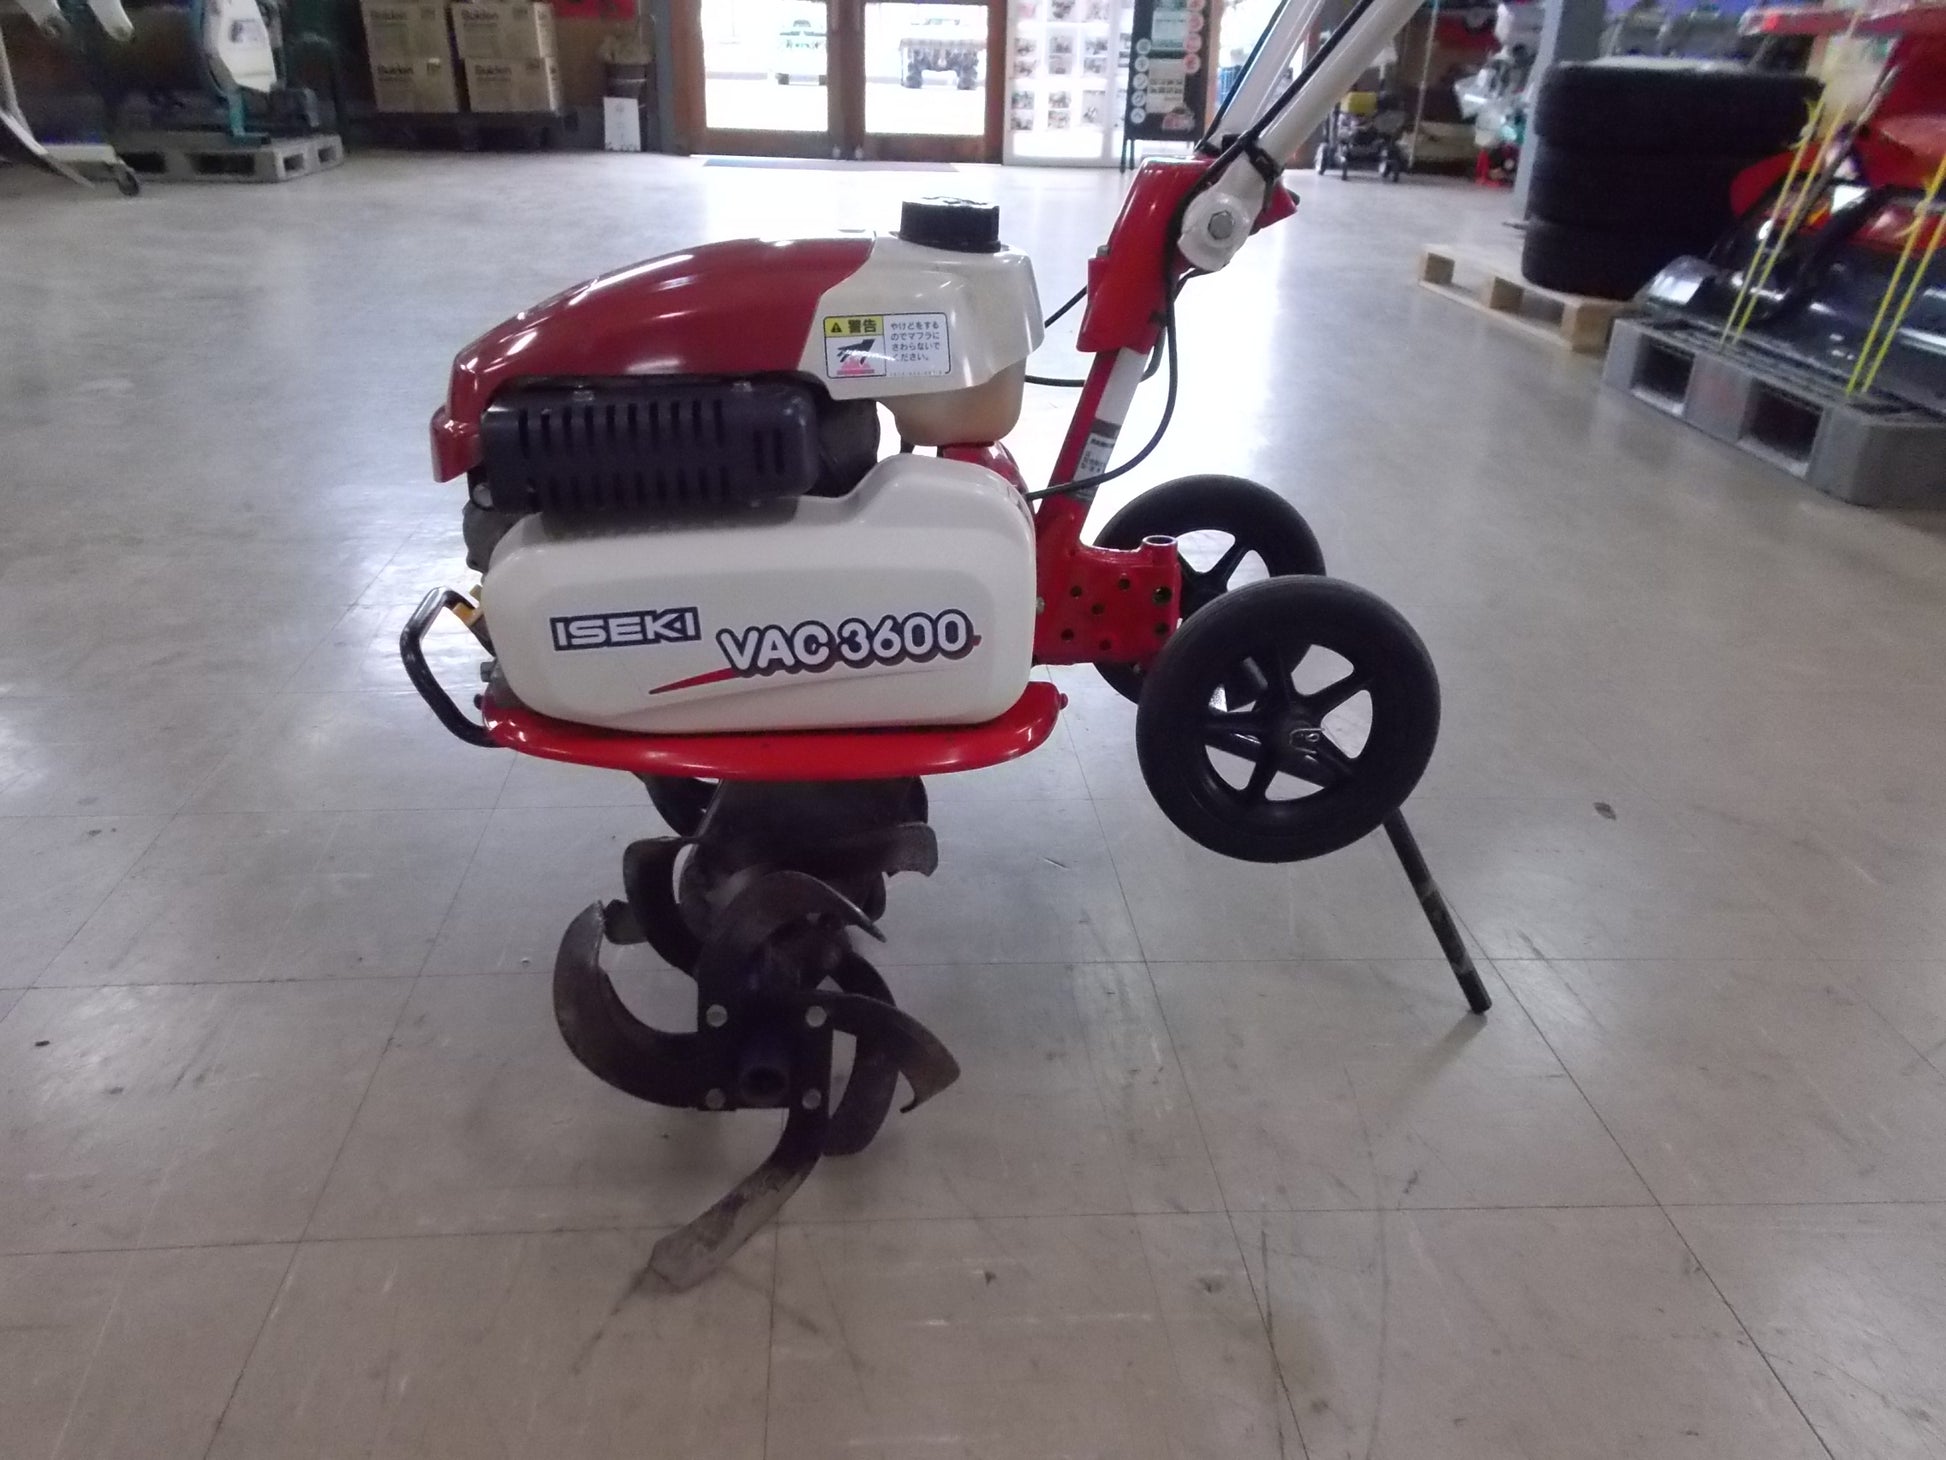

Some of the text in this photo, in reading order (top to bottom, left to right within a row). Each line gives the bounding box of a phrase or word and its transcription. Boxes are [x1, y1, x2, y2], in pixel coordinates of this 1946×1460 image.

[847, 318, 877, 333] 警告
[890, 321, 940, 331] やけどをする
[890, 331, 940, 341] のでマフラに
[891, 342, 940, 351] さわらないで
[553, 609, 698, 649] ISEKI
[718, 610, 971, 674] VAC 3600
